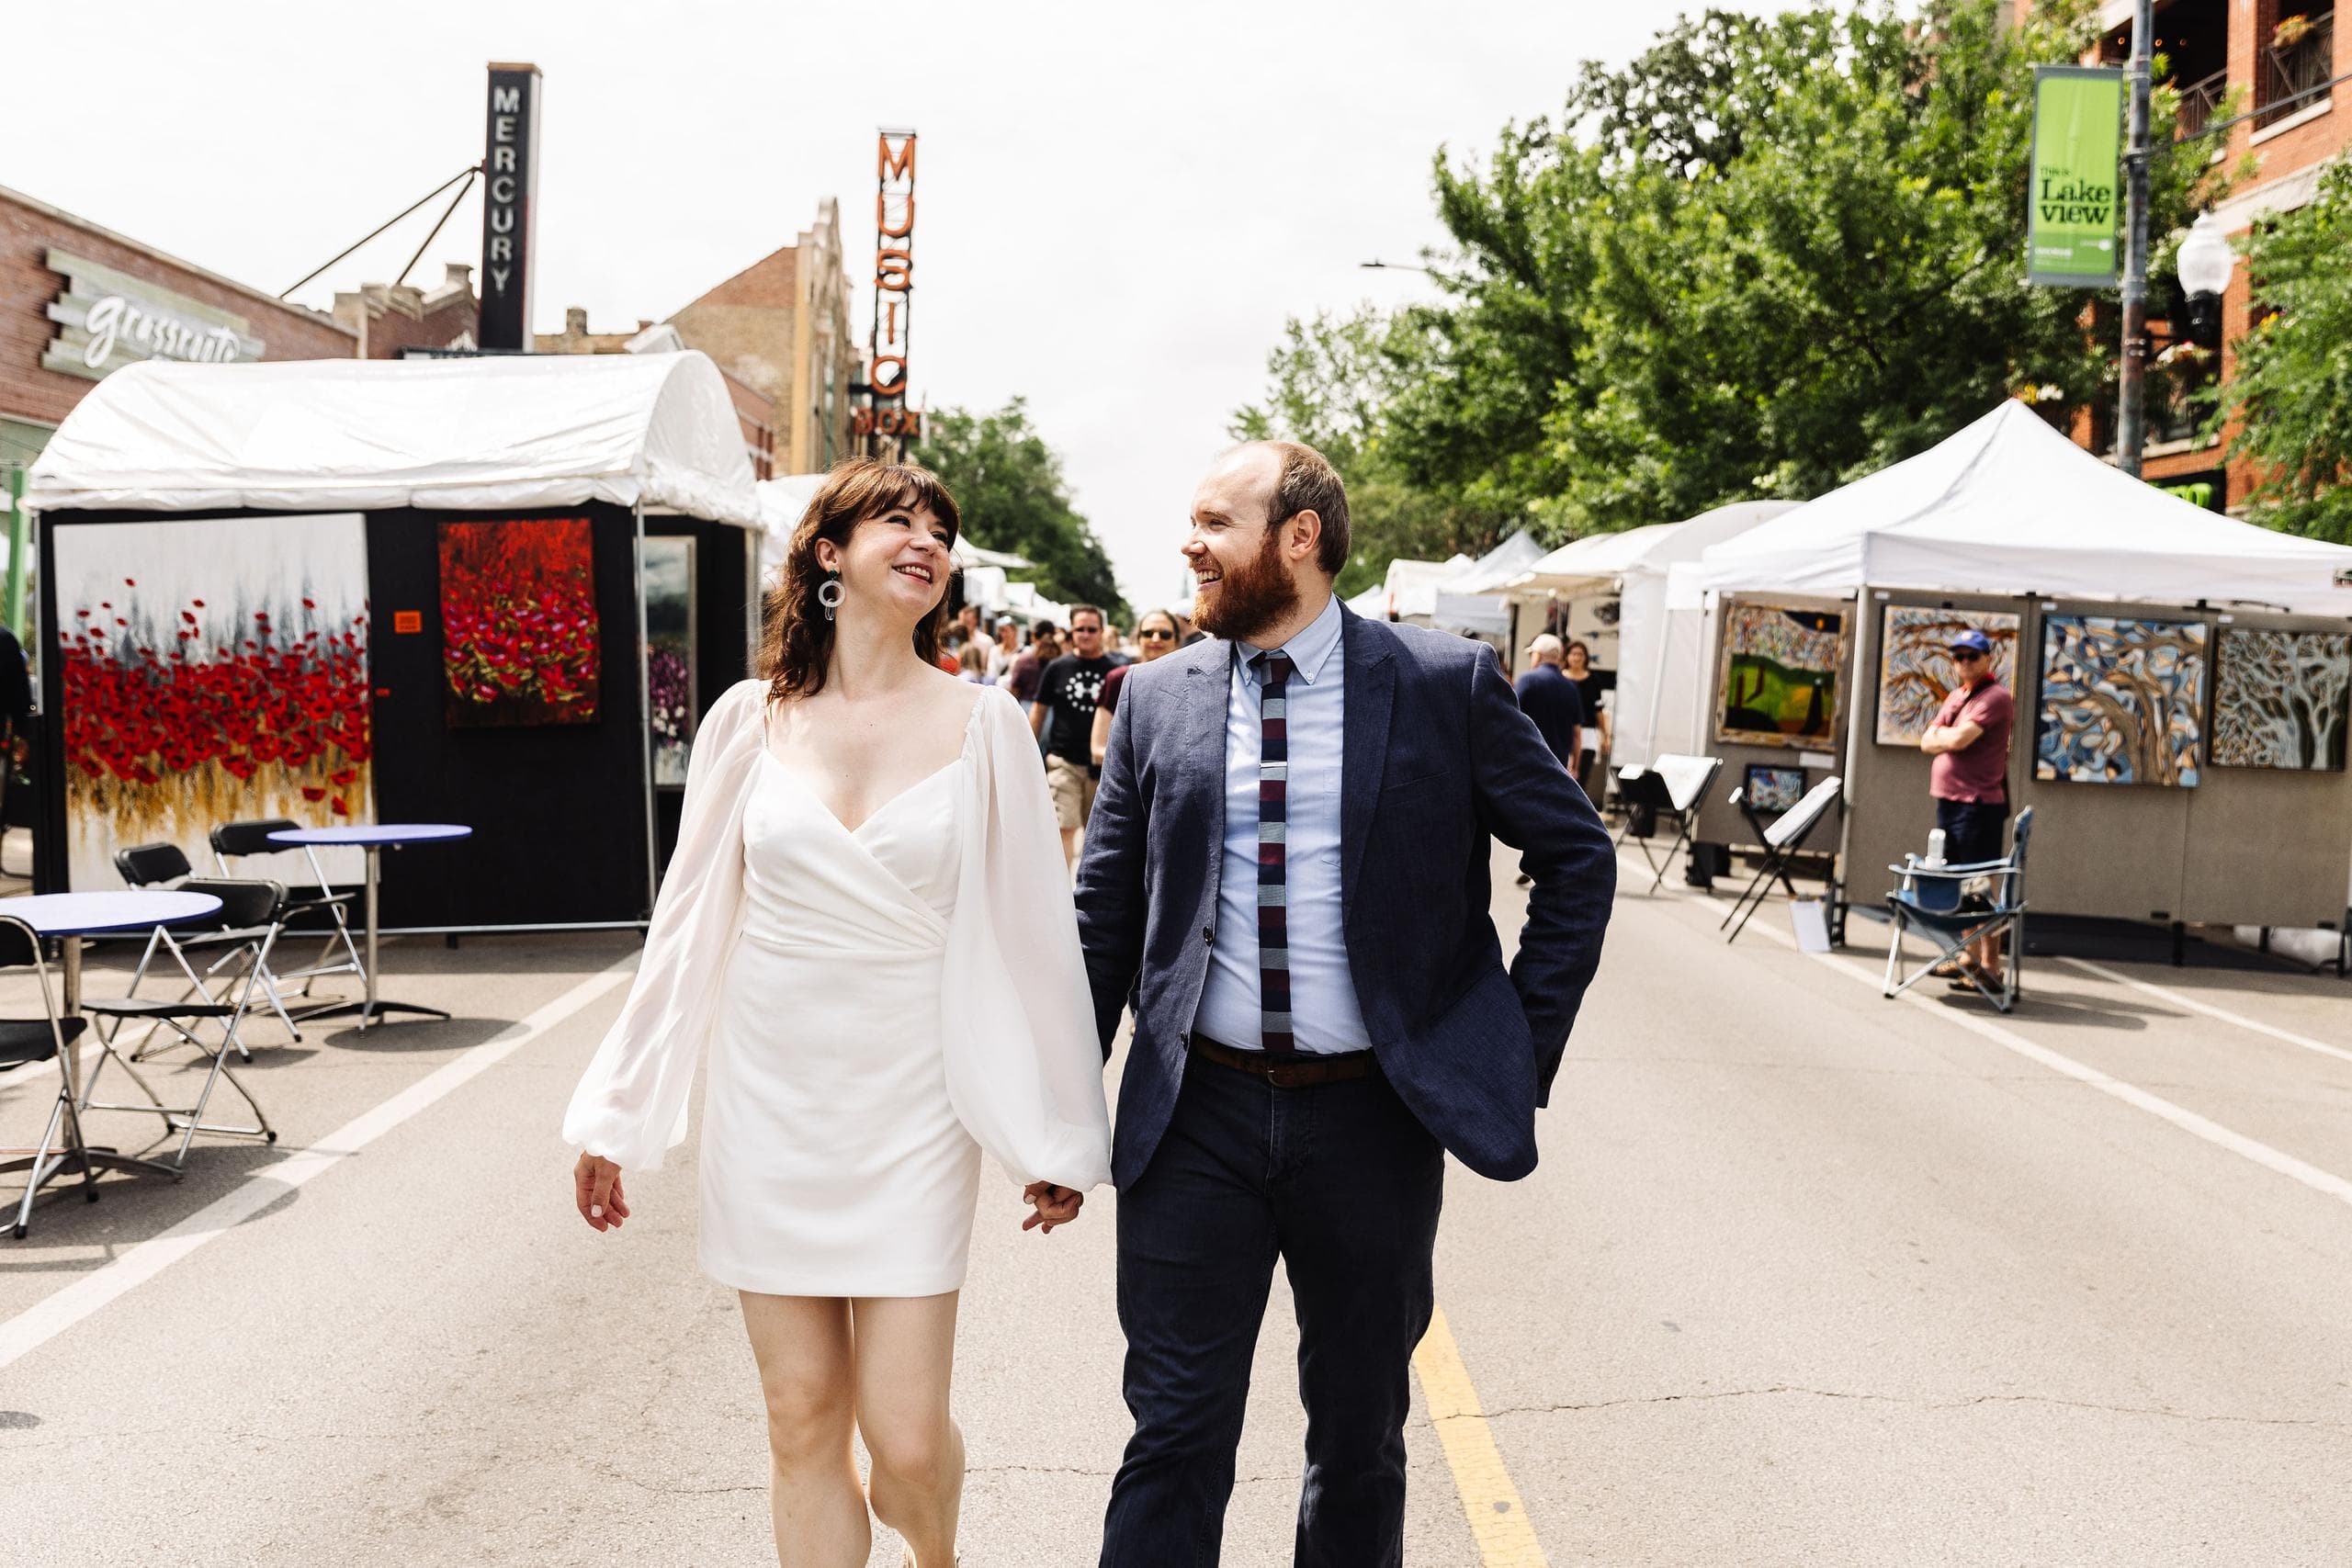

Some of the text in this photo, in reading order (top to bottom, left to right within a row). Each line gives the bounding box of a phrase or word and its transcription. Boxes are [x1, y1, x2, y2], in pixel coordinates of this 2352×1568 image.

[492, 85, 520, 292] MERCURY
[2041, 178, 2110, 202] Lake
[2040, 205, 2109, 224] view
[871, 136, 915, 396] MUSIC
[854, 408, 921, 436] BOX
